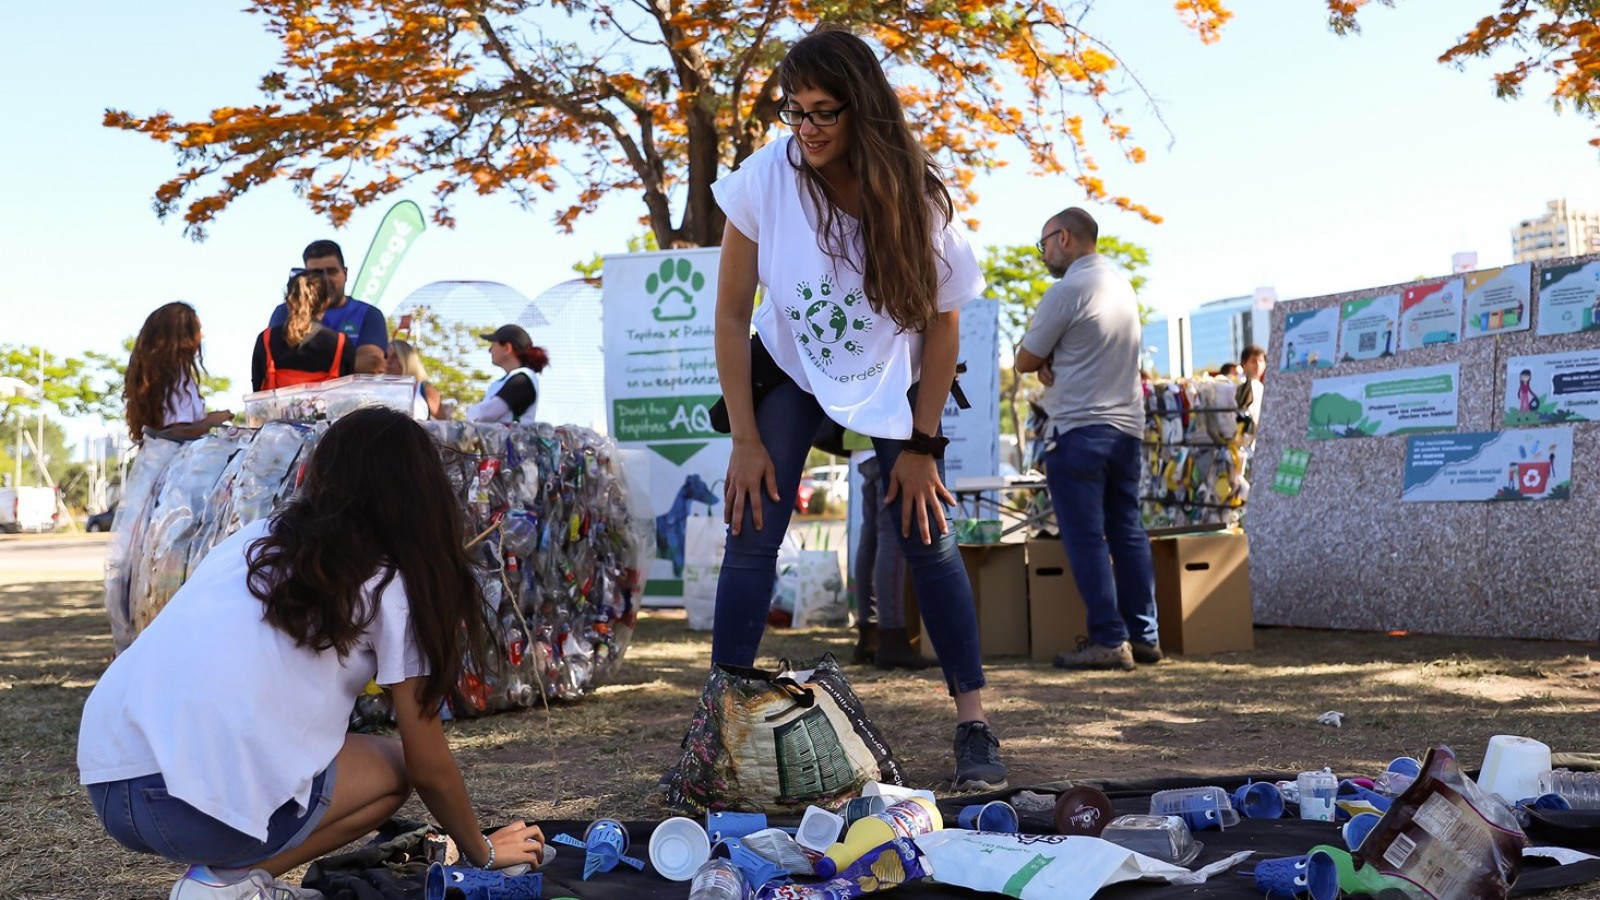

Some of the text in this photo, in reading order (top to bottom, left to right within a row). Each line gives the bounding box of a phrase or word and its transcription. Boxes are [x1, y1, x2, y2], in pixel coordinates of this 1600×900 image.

[627, 328, 665, 344] Tapitas
[680, 357, 716, 377] tapita
[834, 361, 885, 384] erdes
[656, 375, 719, 391] esperanz
[669, 404, 715, 435] AQ
